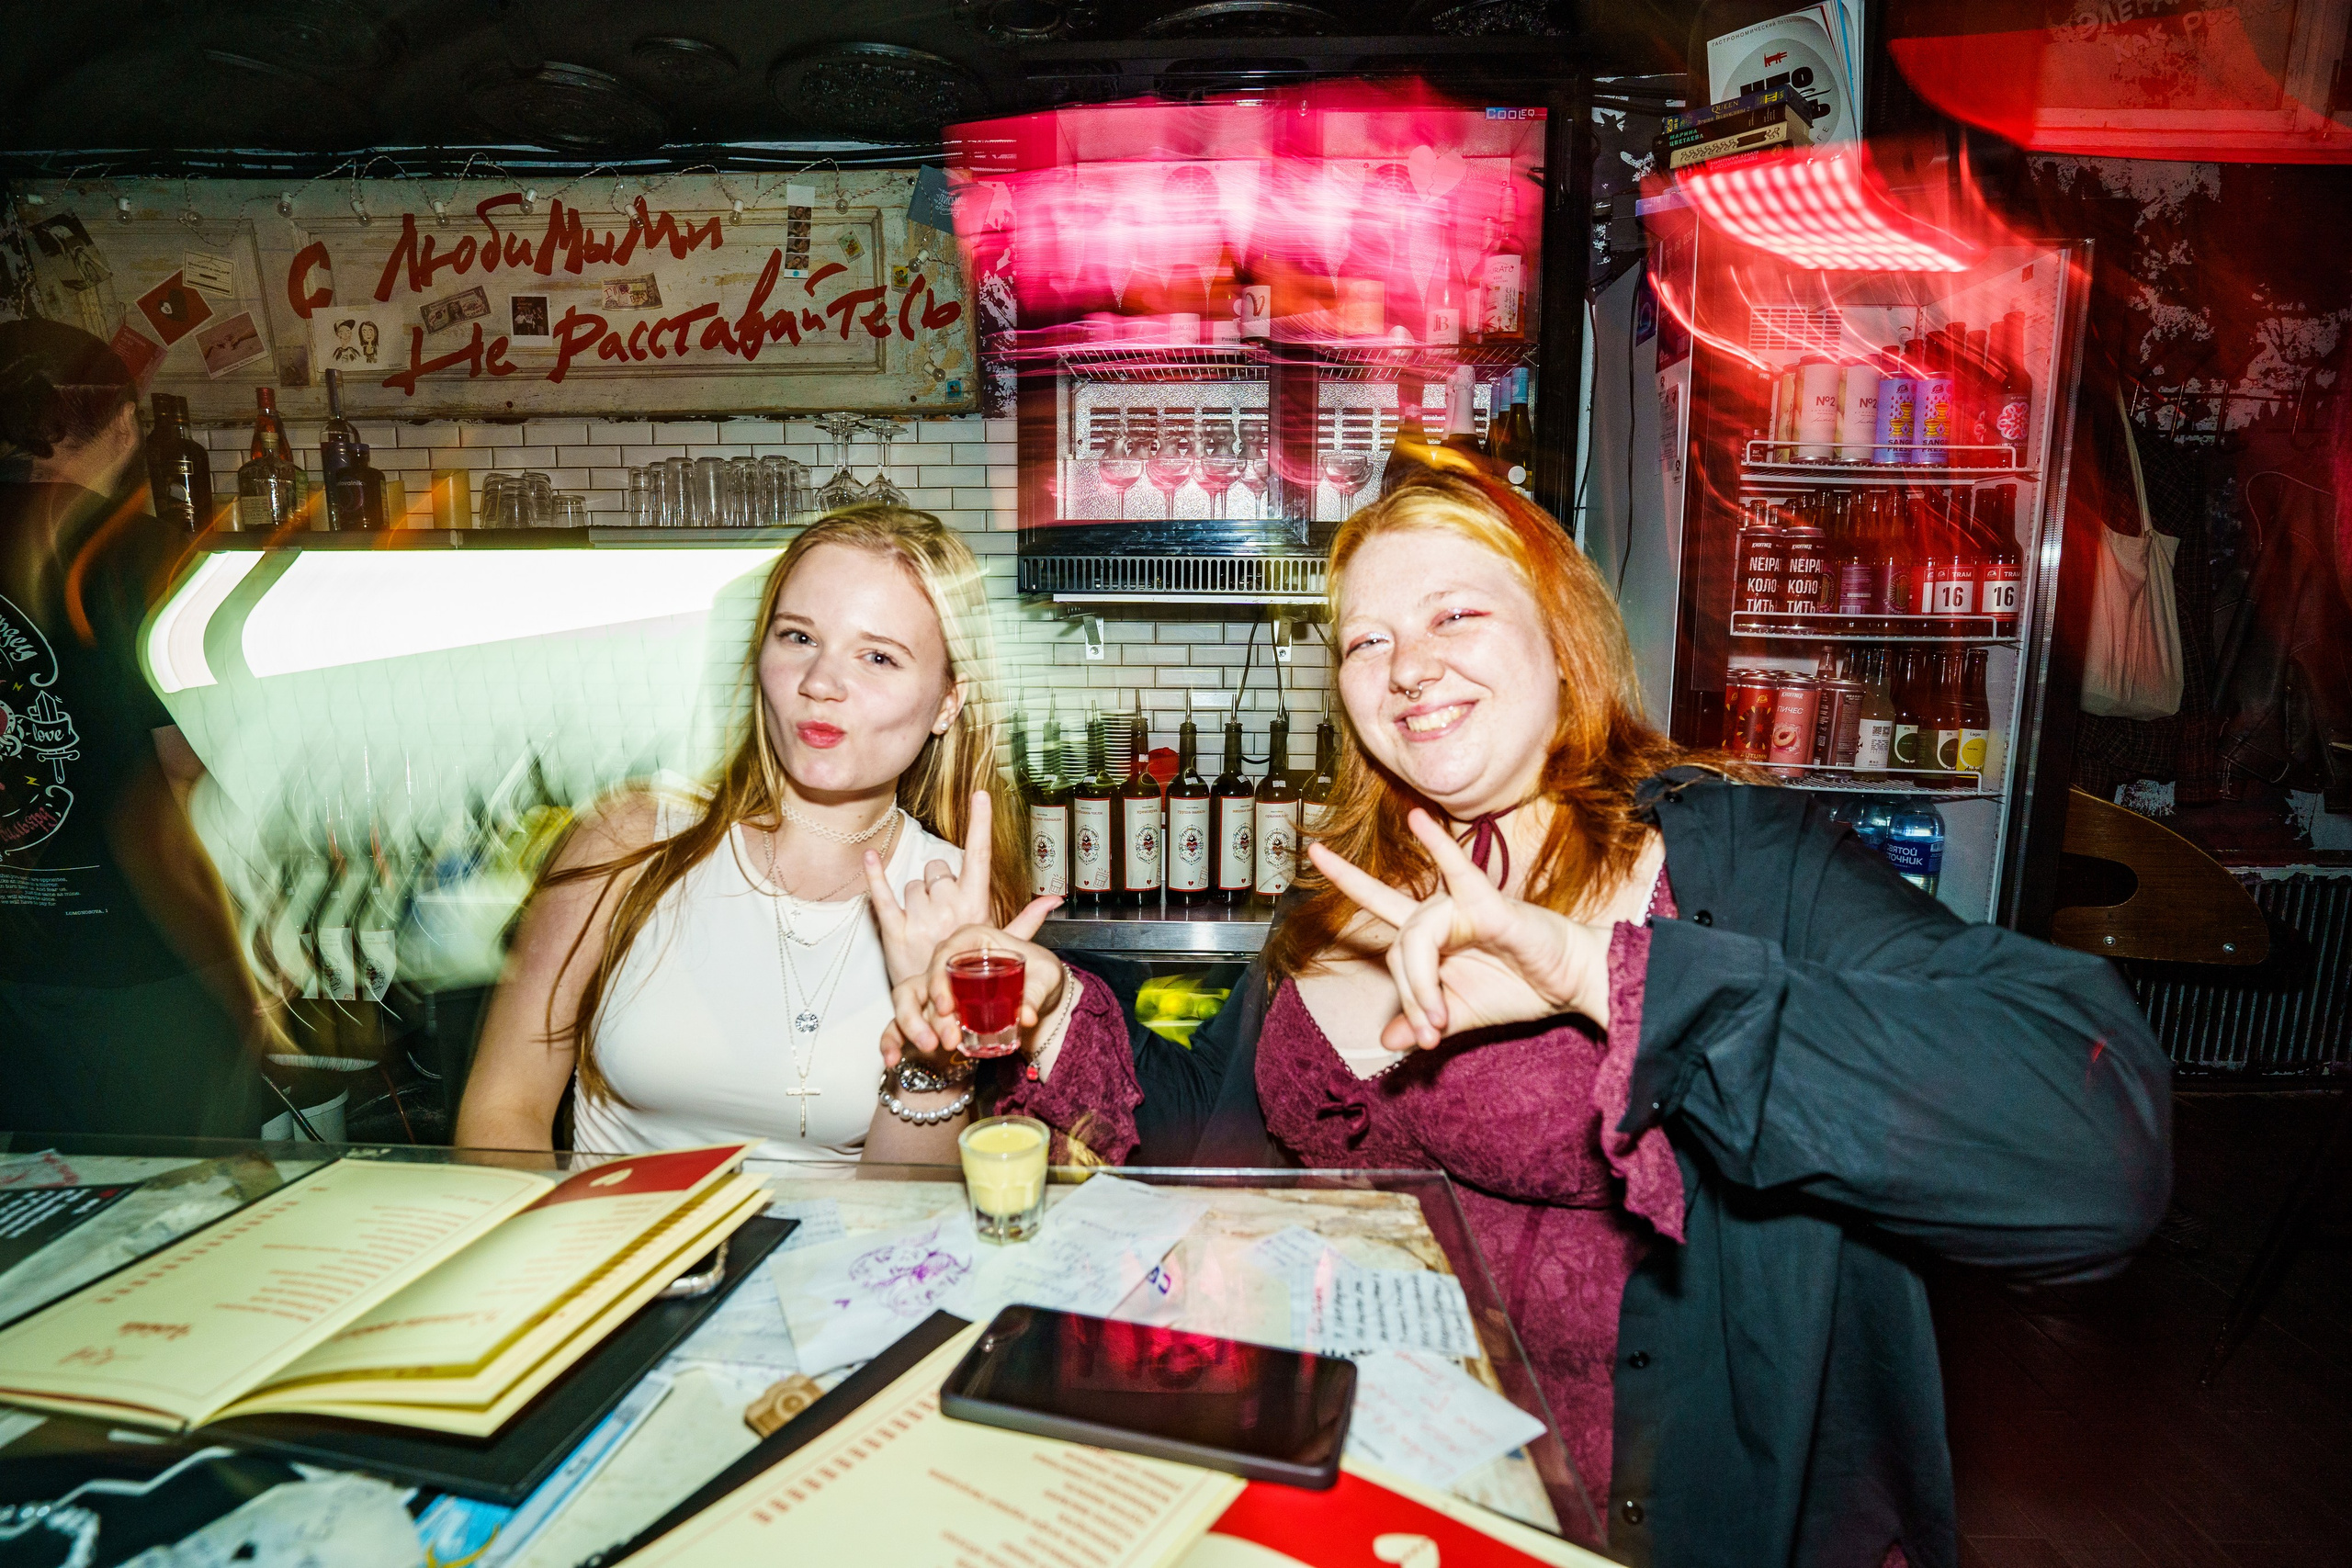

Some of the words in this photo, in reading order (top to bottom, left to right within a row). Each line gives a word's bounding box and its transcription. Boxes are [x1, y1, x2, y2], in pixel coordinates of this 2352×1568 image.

[1712, 100, 1739, 114] QUEEN
[1669, 129, 1698, 141] МАРИНА
[1669, 133, 1703, 147] ЦВЕТАЕВА
[288, 241, 334, 319] С
[1943, 586, 1963, 607] 16
[1994, 586, 2015, 606] 16
[1777, 705, 1804, 715] ПИЧЕС
[32, 723, 64, 742] love
